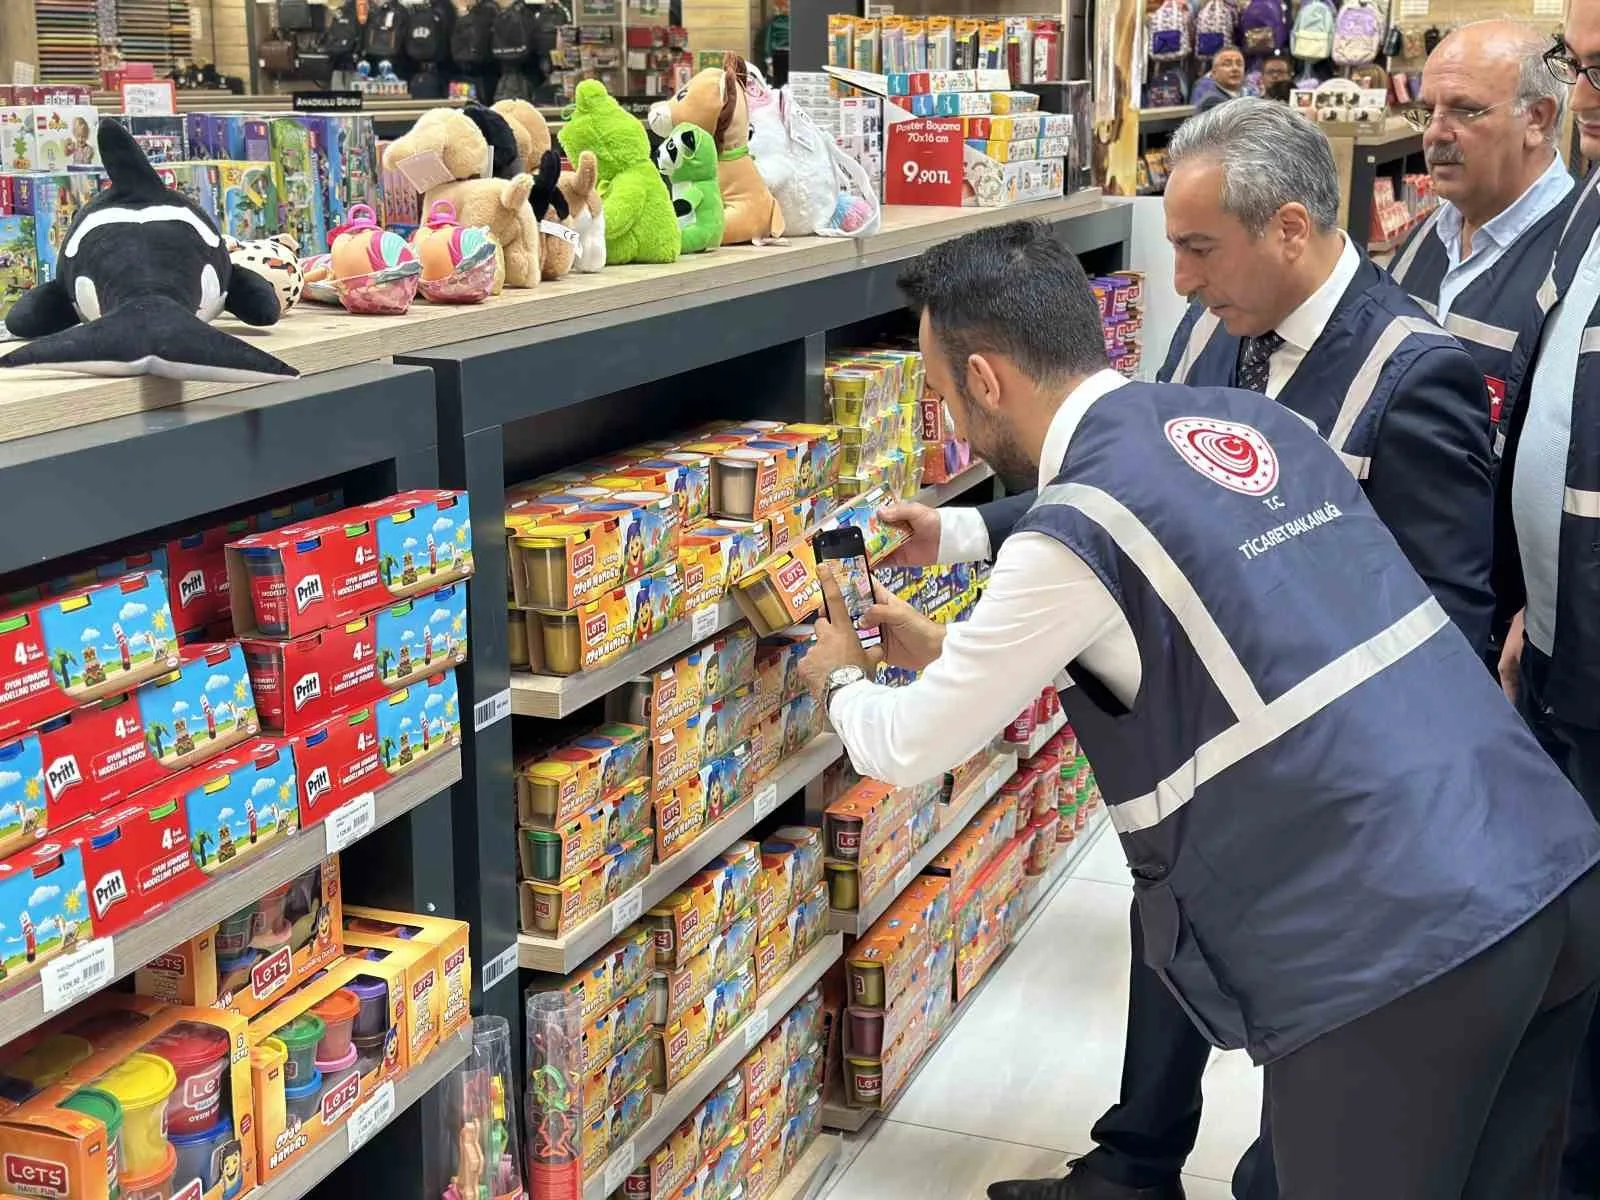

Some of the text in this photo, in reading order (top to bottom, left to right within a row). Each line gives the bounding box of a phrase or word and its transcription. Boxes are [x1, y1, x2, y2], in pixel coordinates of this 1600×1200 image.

[896, 120, 960, 132] Poster Boyama
[908, 133, 934, 142] 70x16
[1238, 526, 1290, 560] TİCARET
[355, 546, 364, 565] 4
[181, 573, 204, 594] Pritt
[298, 580, 320, 602] Pritt
[15, 641, 27, 665] 4
[354, 642, 362, 660] 4
[296, 676, 317, 701] Pritt
[115, 716, 126, 739] 4
[358, 733, 366, 750] 4
[48, 762, 75, 788] Pritt
[308, 771, 327, 794] Pritt
[162, 827, 172, 850] 4
[96, 877, 120, 904] Pritt
